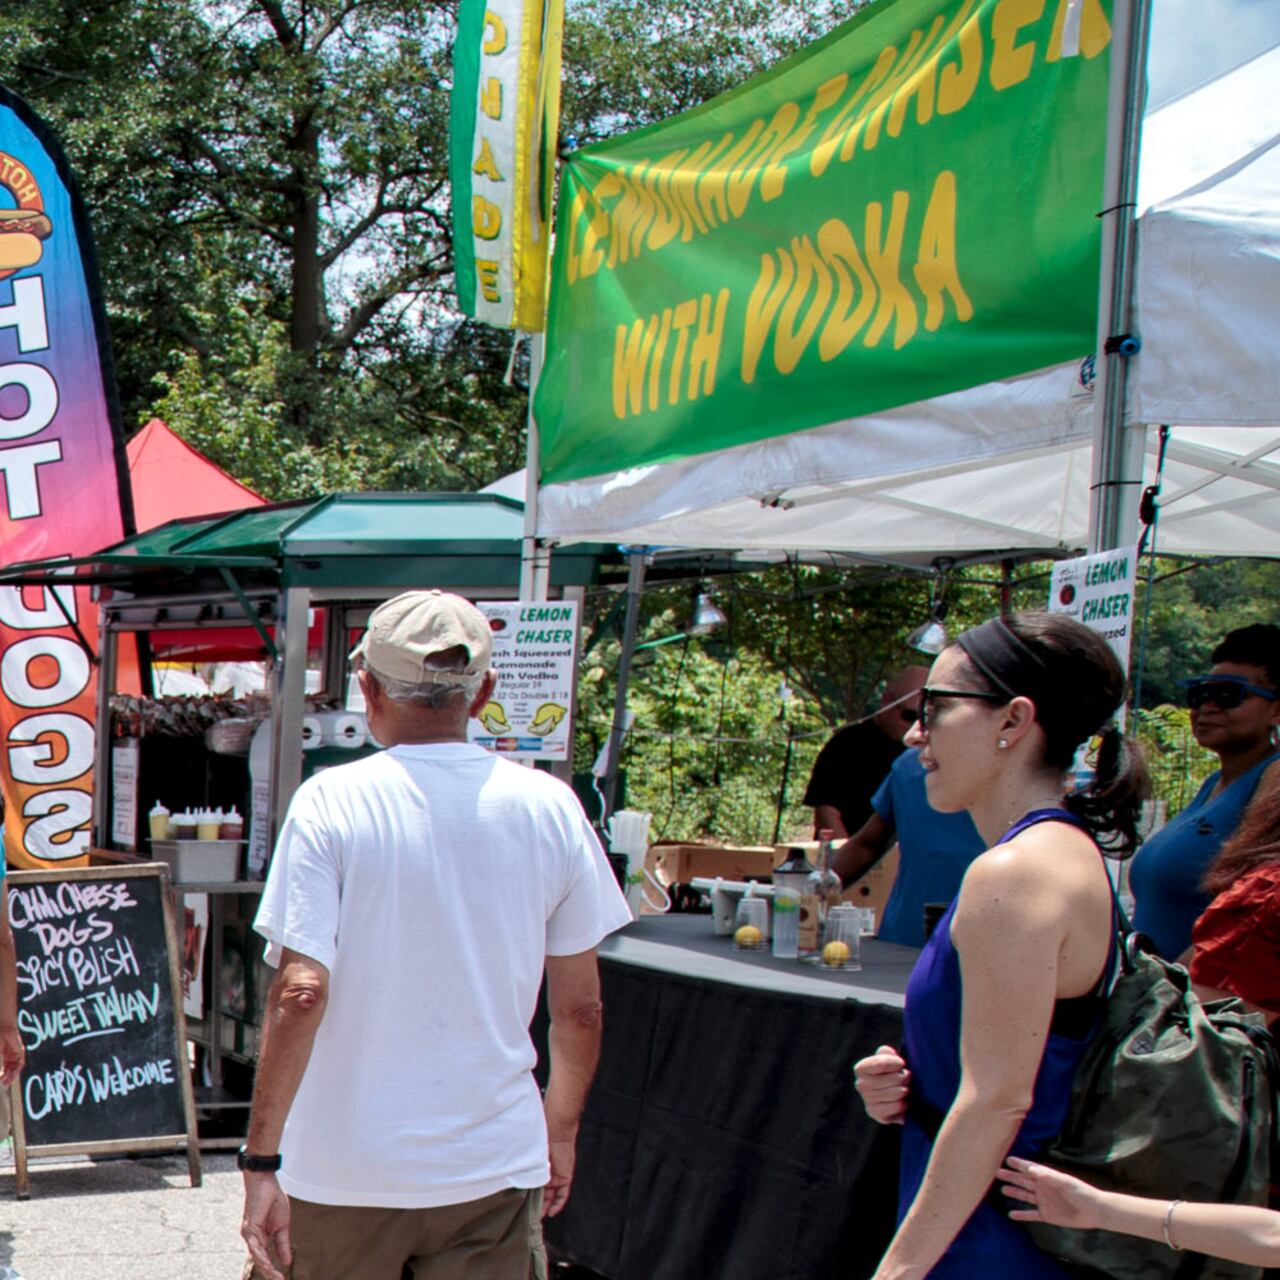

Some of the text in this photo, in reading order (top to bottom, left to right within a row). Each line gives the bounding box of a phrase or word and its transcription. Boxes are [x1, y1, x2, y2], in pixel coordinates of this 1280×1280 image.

[612, 170, 974, 420] WITH VODKA
[1084, 557, 1128, 587] LEMON
[519, 607, 572, 621] LEMON
[1082, 593, 1130, 623] CHASER
[516, 629, 573, 643] CHASER
[491, 649, 571, 658] esh Squeezed
[491, 661, 556, 669] Lemonade
[498, 671, 558, 680] ith Vodka
[56, 882, 138, 914] CHEESE
[28, 912, 114, 956] DOGS
[17, 997, 91, 1051] SWEET
